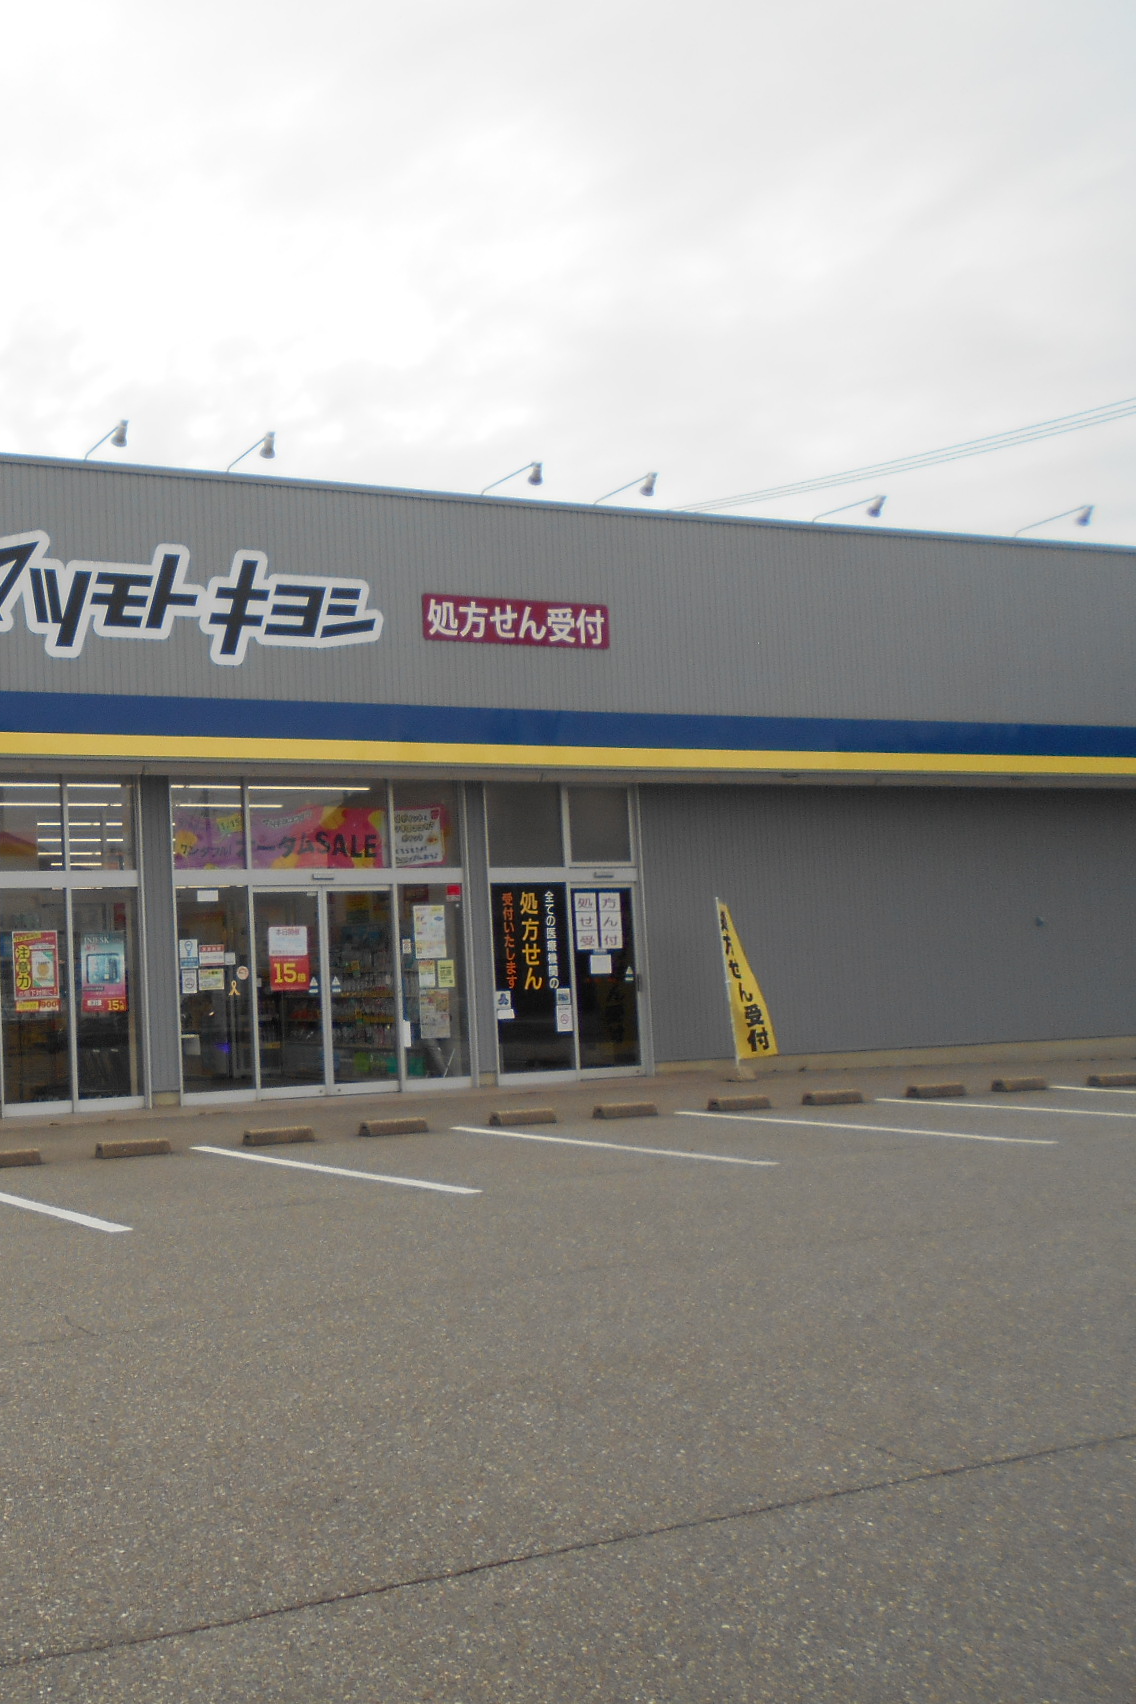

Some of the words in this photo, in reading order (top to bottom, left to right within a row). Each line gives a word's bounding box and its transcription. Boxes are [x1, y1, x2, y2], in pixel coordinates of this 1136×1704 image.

[427, 598, 605, 645] 処方せん受付
[16, 946, 31, 988] 注意力
[501, 892, 518, 989] 受付いたします
[519, 891, 543, 991] 処方せん
